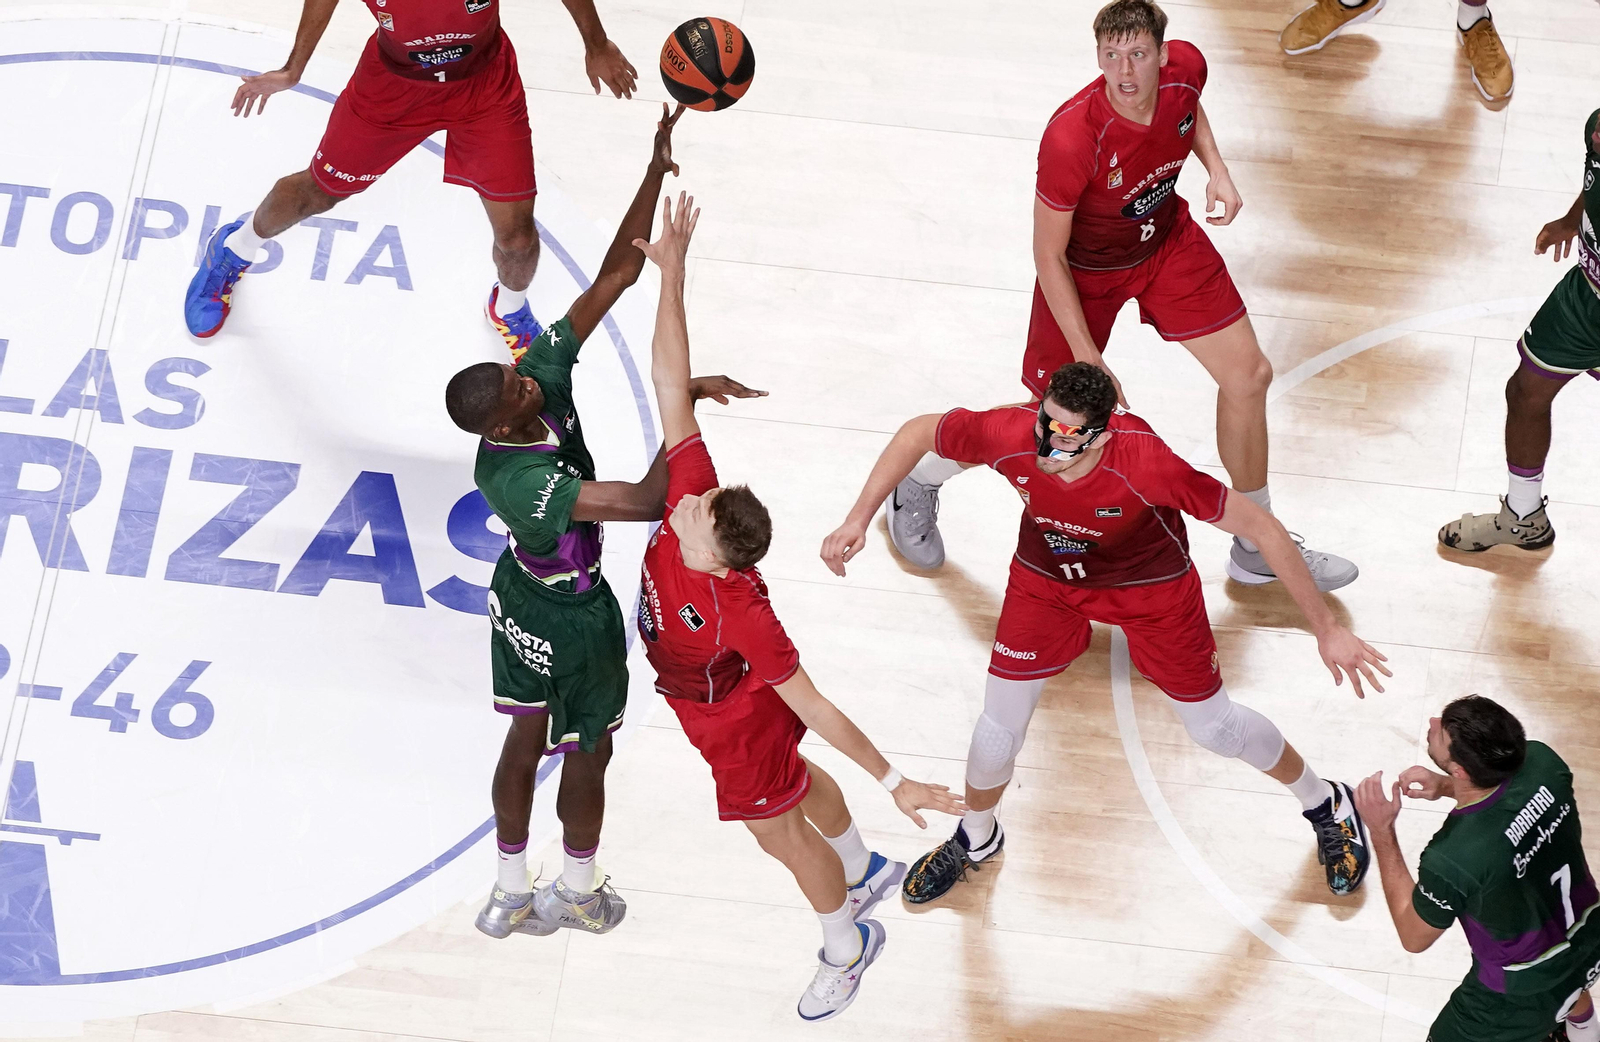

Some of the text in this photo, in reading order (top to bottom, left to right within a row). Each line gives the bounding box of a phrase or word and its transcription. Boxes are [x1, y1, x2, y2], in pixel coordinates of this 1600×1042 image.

[664, 44, 687, 72] 1000
[433, 70, 447, 83] 1
[1059, 562, 1087, 580] 11
[505, 617, 554, 656] COSTA
[524, 648, 553, 667] SOL
[1504, 785, 1556, 848] BARREIRO
[1550, 863, 1576, 930] 7
